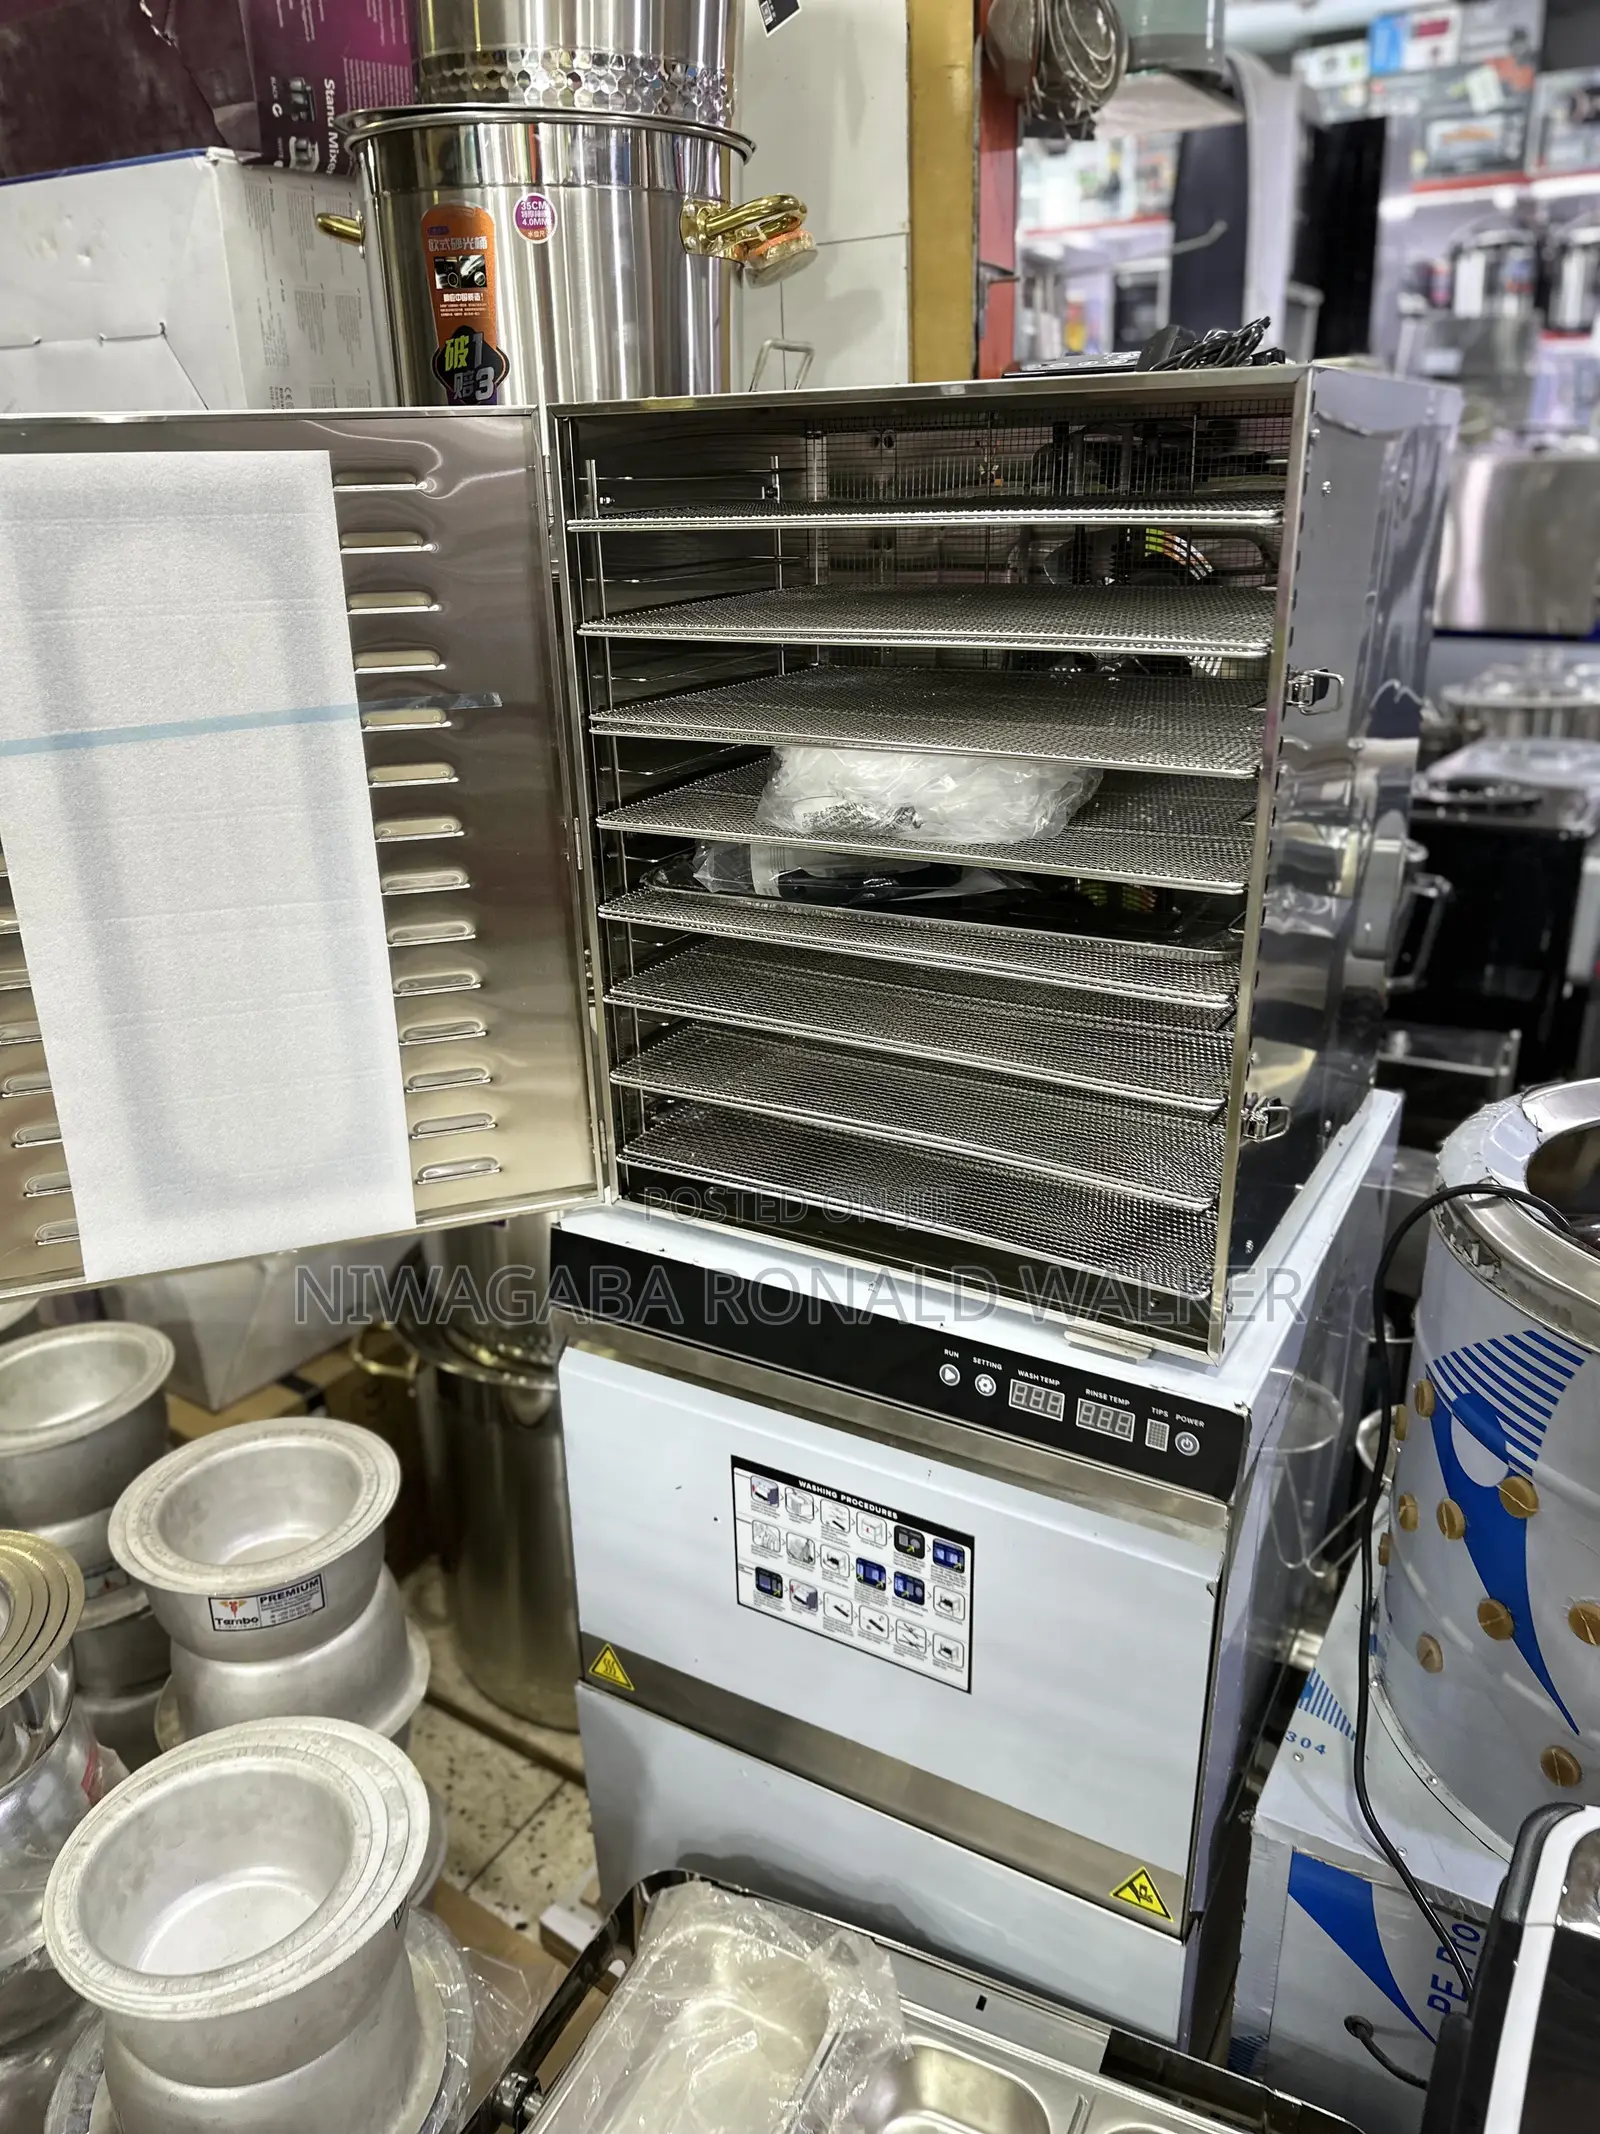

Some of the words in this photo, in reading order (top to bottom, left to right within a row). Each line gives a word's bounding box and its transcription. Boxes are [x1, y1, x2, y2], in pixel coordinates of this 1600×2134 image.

[521, 200, 549, 211] 35CM
[944, 1348, 960, 1359] RUN
[972, 1356, 1003, 1371] SETTING
[1017, 1369, 1039, 1381] WASH
[1039, 1373, 1061, 1387] TEMP
[1085, 1388, 1108, 1400] RINSE
[1108, 1393, 1131, 1407] TEMP
[1151, 1406, 1169, 1418] TIPS
[1175, 1413, 1206, 1429] POWER
[798, 1479, 838, 1500] WASHING
[840, 1493, 899, 1521] PROCEDURES
[259, 1579, 319, 1604] PREMIUM
[214, 1616, 259, 1625] Tambo
[1285, 1731, 1326, 1755] 304
